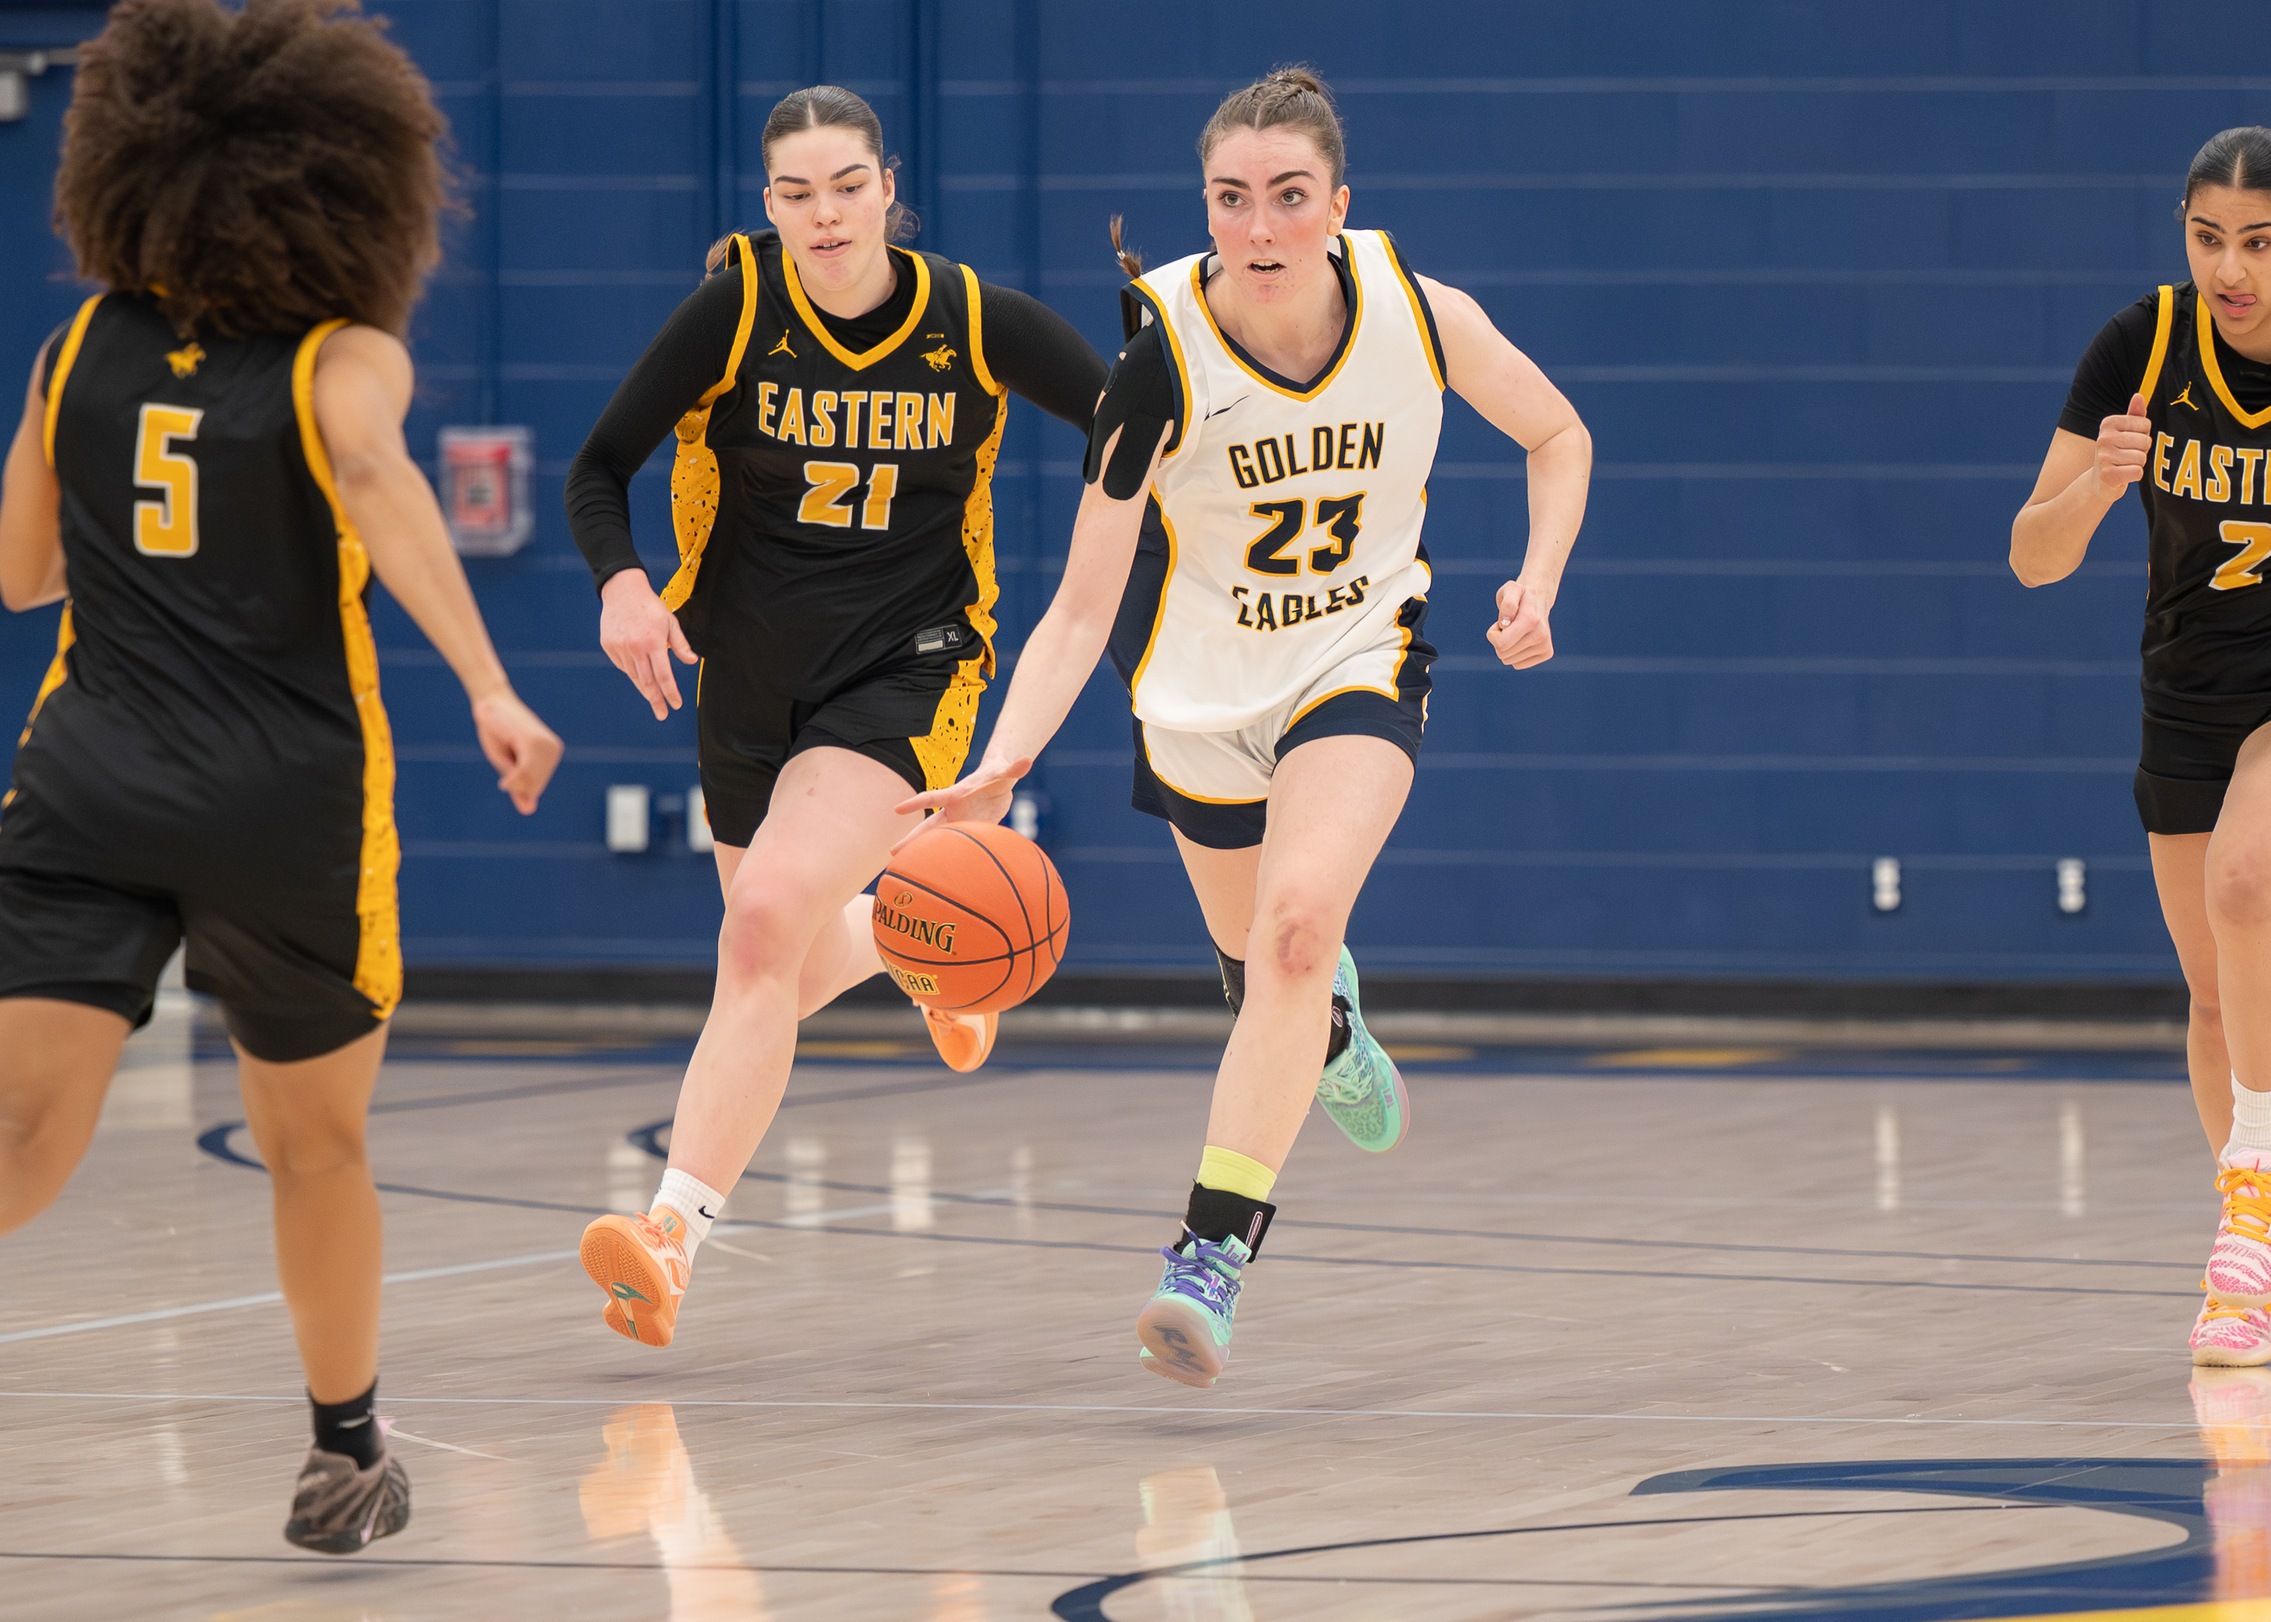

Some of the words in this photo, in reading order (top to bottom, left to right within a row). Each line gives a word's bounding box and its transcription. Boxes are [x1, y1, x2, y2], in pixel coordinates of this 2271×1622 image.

[758, 381, 957, 451] EASTERN
[133, 402, 204, 559] 5
[1227, 421, 1385, 489] GOLDEN
[797, 460, 899, 531] 21
[1243, 490, 1368, 578] 23
[2208, 519, 2271, 591] 2
[946, 631, 959, 642] XL
[1232, 575, 1370, 633] EAGLES
[872, 900, 956, 955] PALDING
